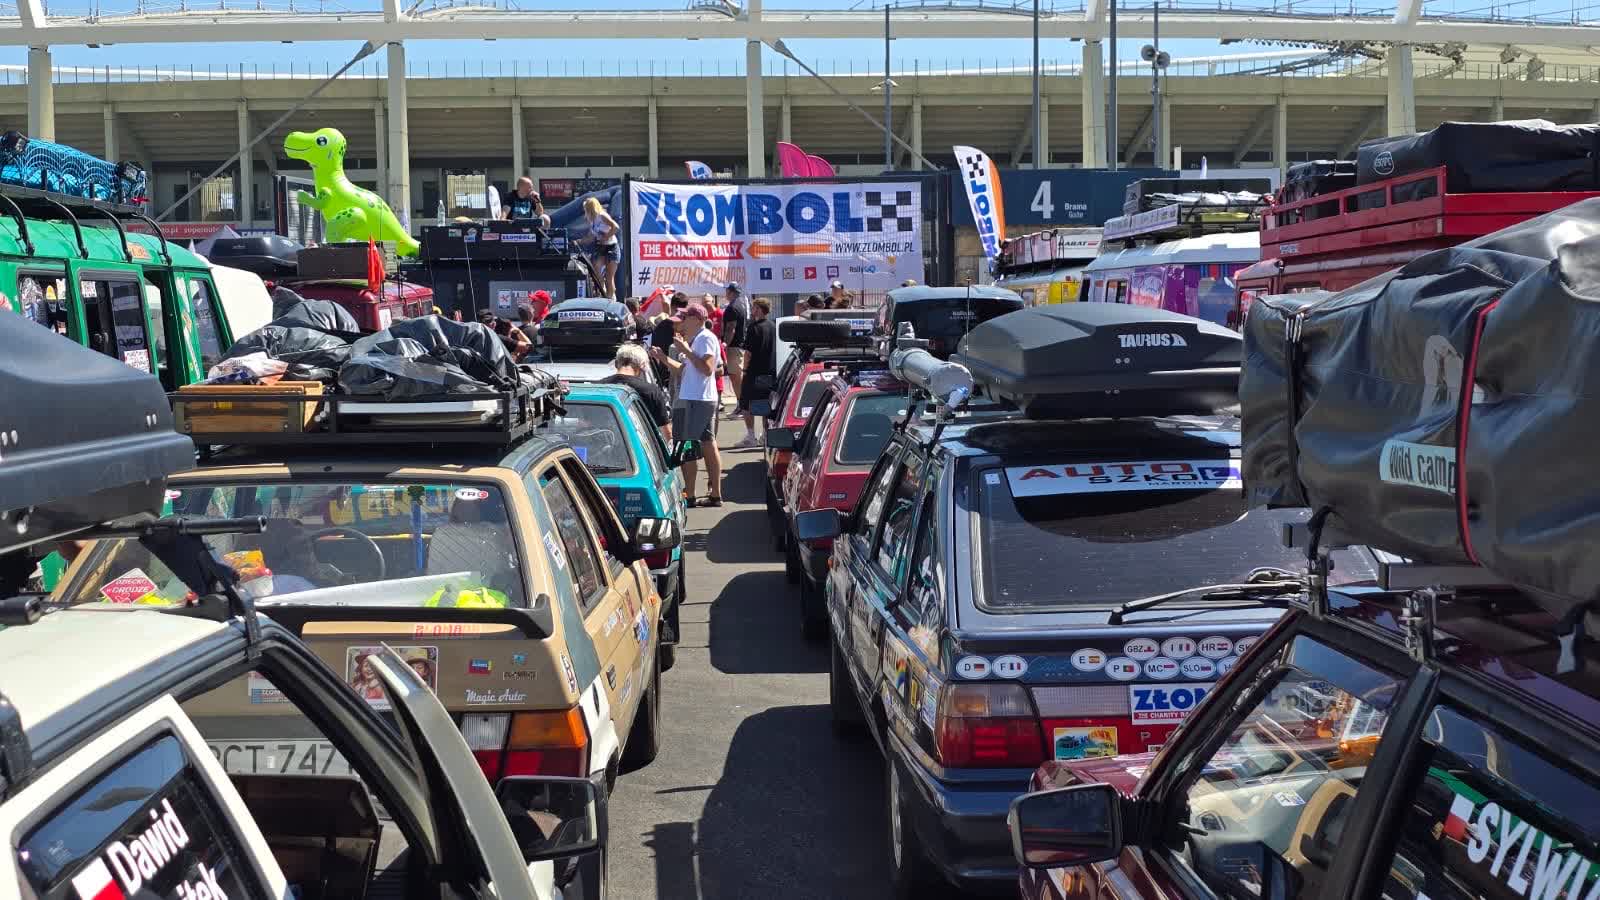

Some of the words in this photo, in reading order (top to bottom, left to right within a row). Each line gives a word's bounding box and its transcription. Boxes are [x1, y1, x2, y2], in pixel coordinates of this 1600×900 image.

[1030, 180, 1054, 219] 4
[1064, 203, 1087, 211] Brama
[638, 191, 864, 236] ZŁOMBOL
[643, 243, 661, 258] THE
[665, 243, 709, 259] CHARITY
[711, 245, 740, 258] RALLY
[1117, 333, 1171, 348] TAURUS
[1389, 445, 1412, 481] Wild
[1018, 462, 1194, 481] AUTO
[1202, 643, 1216, 652] HR
[1000, 662, 1006, 672] F
[1079, 655, 1086, 664] E
[964, 663, 971, 672] D
[1113, 664, 1120, 673] P
[1148, 664, 1163, 673] MC
[466, 690, 496, 704] Magic
[499, 688, 526, 702] Auto
[1150, 711, 1178, 719] CHARITY
[278, 743, 354, 775] 747
[106, 798, 190, 897] Dawid
[1467, 802, 1600, 900] SYLWI
